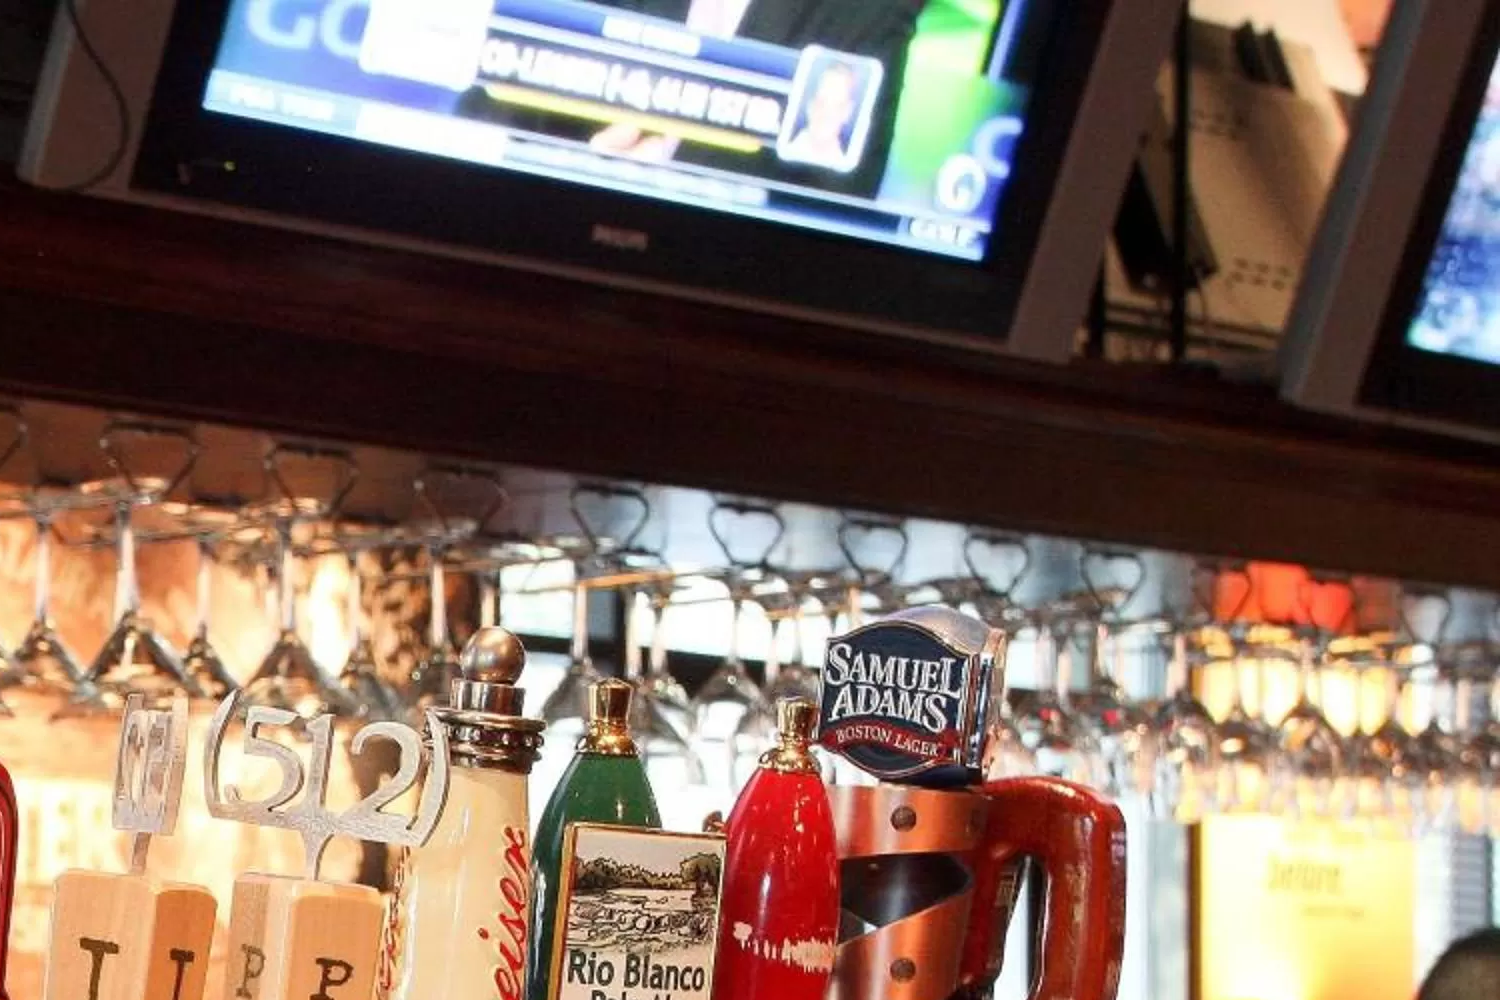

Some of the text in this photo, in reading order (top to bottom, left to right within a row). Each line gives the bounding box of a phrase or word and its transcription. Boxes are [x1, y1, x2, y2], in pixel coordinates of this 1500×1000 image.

[825, 642, 961, 699] SAMUEL
[827, 683, 947, 734] ADAMS
[835, 724, 939, 757] BOSTON LAGER
[567, 949, 706, 992] Rio Blanco
